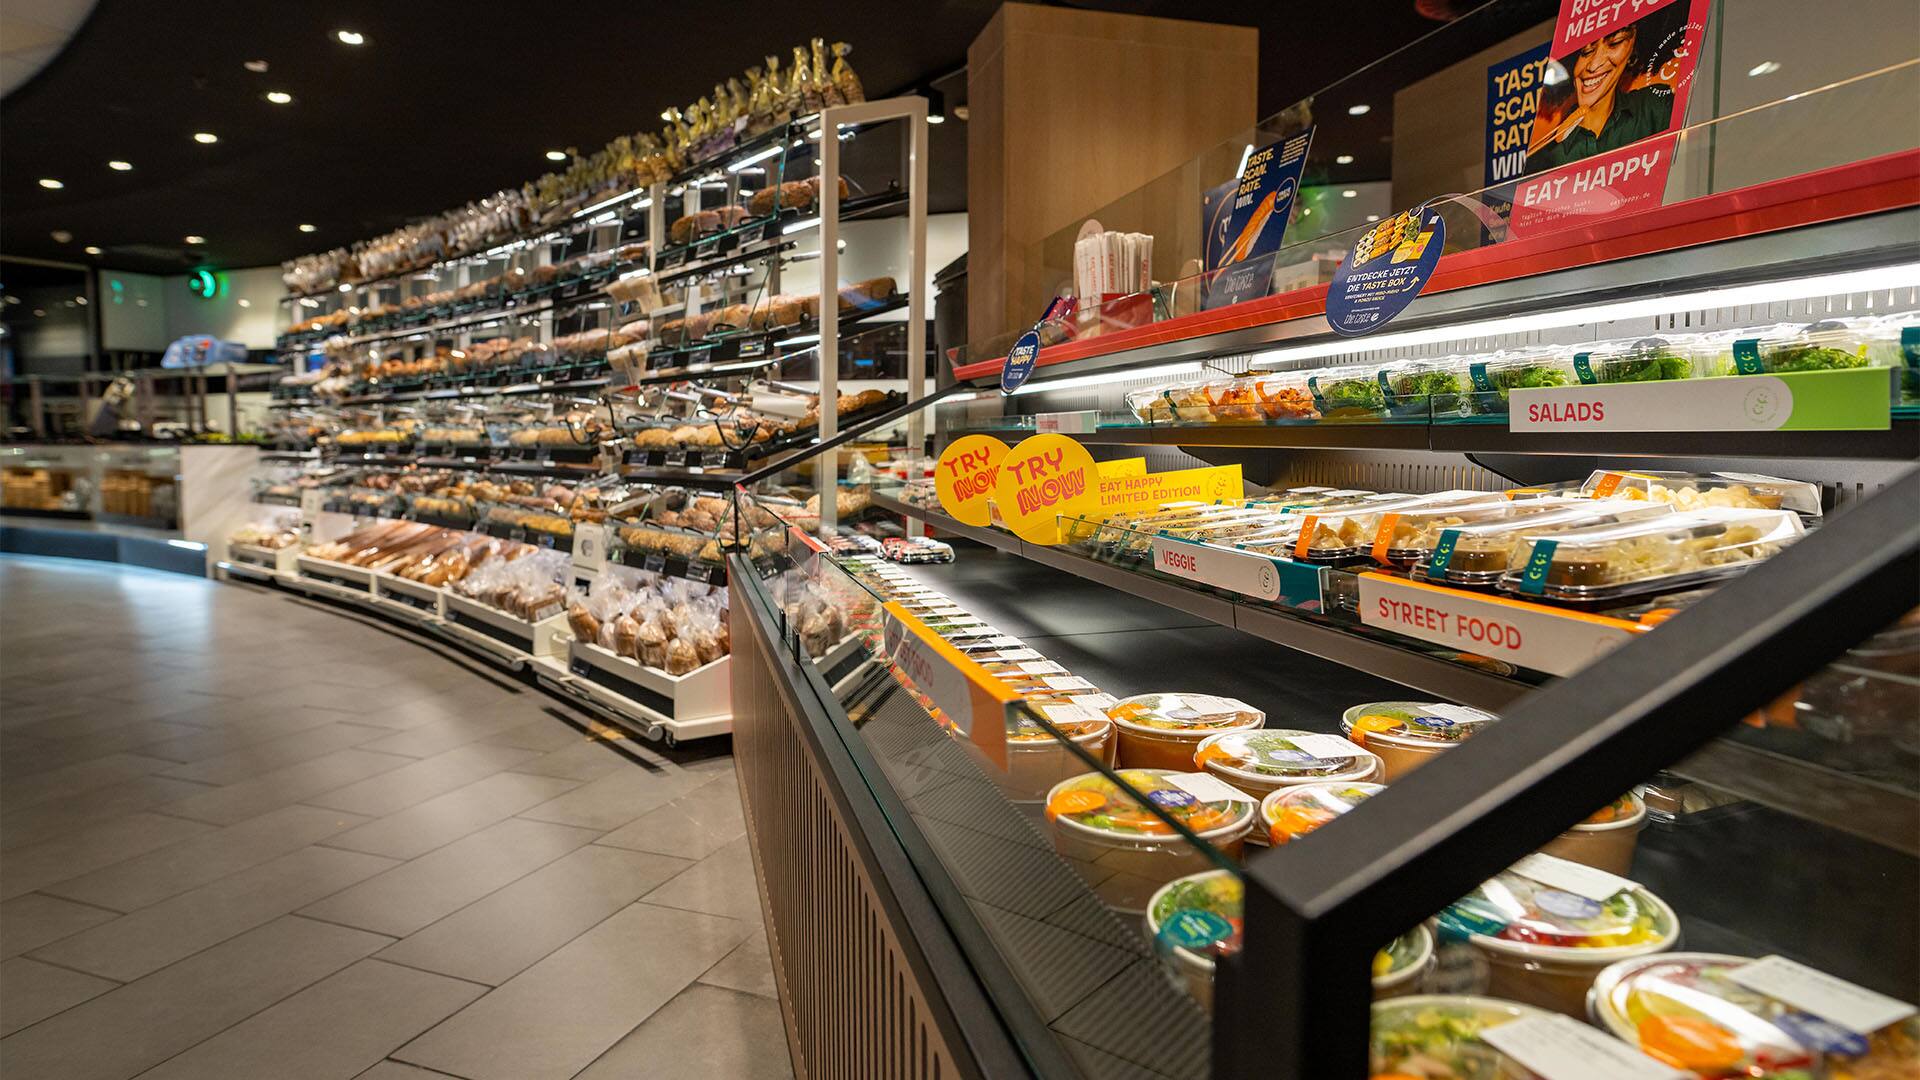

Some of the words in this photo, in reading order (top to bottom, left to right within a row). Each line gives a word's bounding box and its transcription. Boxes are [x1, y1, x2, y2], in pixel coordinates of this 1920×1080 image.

[1565, 0, 1626, 43] MEET
[1494, 57, 1549, 97] TAST
[1493, 119, 1534, 154] RAT
[1523, 176, 1569, 207] EAT
[1572, 150, 1661, 195] HAPPY
[1346, 269, 1390, 284] ENTDECKE
[1389, 265, 1418, 277] JETZT
[1346, 283, 1361, 293] DIE
[1362, 280, 1387, 291] TASTE
[1387, 277, 1407, 287] BOX
[1010, 354, 1033, 365] HAPPY
[1014, 345, 1036, 356] TASTE
[1528, 401, 1605, 422] SALADS
[943, 446, 991, 478] TRY
[1007, 447, 1064, 485] TRY
[1016, 467, 1086, 517] NOW
[1100, 480, 1121, 493] EAT
[1125, 476, 1163, 490] HAPPY
[1100, 490, 1149, 506] LIMITED
[1152, 485, 1201, 500] EDITION
[1162, 549, 1197, 573] VEGGIE
[1378, 596, 1450, 633] STREET
[1456, 615, 1522, 650] FOOD
